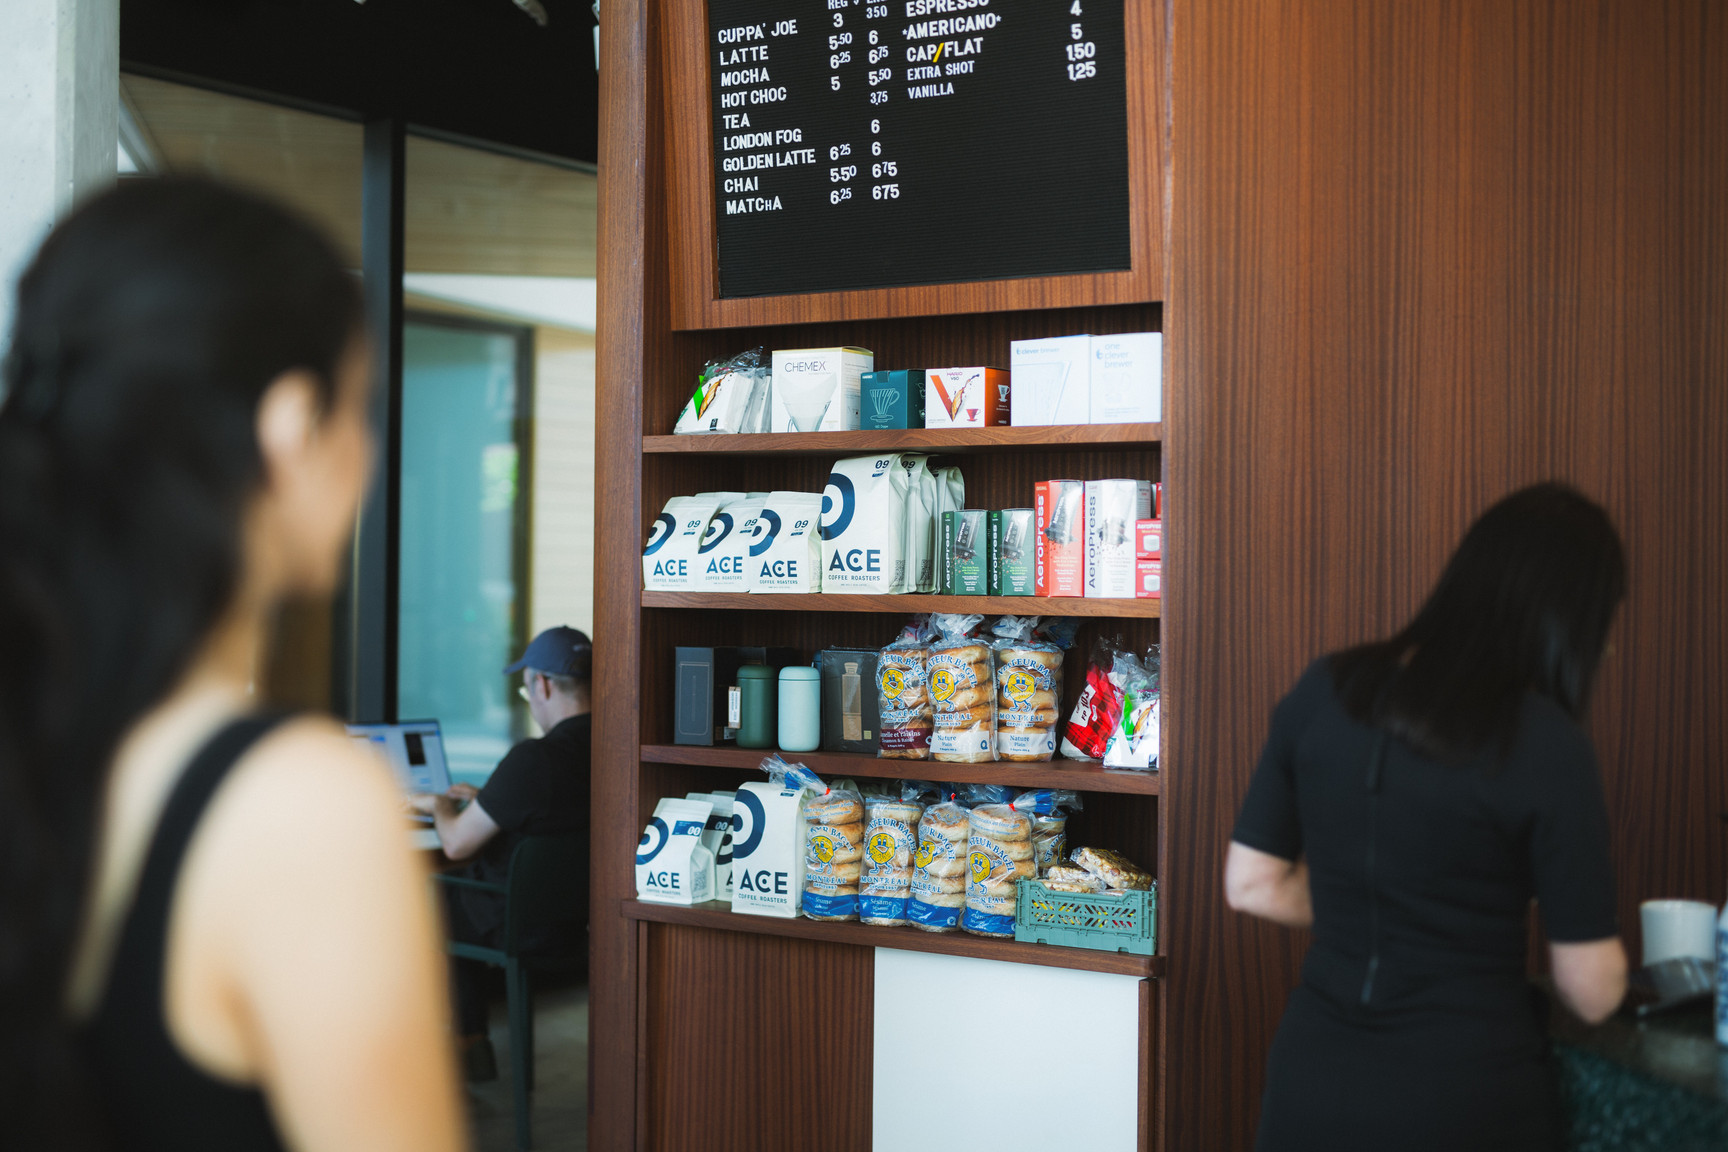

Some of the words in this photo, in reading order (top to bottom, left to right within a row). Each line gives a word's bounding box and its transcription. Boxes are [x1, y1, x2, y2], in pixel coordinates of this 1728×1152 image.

[1070, 0, 1082, 16] 4
[771, 19, 798, 37] JOE
[833, 12, 844, 28] 3
[1071, 23, 1083, 40] 5
[719, 45, 769, 66] LATTE
[868, 30, 879, 45] 6
[721, 67, 770, 87] MOCHA
[907, 65, 941, 81] EXTRA
[945, 60, 975, 76] SHOT
[721, 91, 748, 108] HOT
[750, 86, 787, 105] CHOC
[830, 76, 841, 91] 5
[908, 82, 954, 99] VANILLA
[723, 112, 750, 129] TEA
[723, 131, 772, 151] LONDON
[776, 128, 802, 145] FOG
[871, 119, 881, 134] 6
[723, 152, 774, 172] GOLDEN
[776, 149, 816, 167] LATTE
[872, 141, 882, 156] 6
[724, 176, 759, 193] CHAI
[784, 360, 827, 373] CHEMEX
[875, 460, 889, 469] 09
[687, 520, 701, 528] 09
[744, 518, 758, 527] 09
[794, 519, 809, 529] 09
[1088, 496, 1096, 588] AeroPress
[653, 559, 688, 576] ACE
[706, 556, 743, 574] ACE
[760, 560, 798, 578] ACE
[829, 548, 880, 572] ACE
[955, 658, 977, 687] BAGEL
[646, 870, 680, 889] ACE
[739, 868, 788, 895] ACE
[760, 896, 787, 904] ROASTERS
